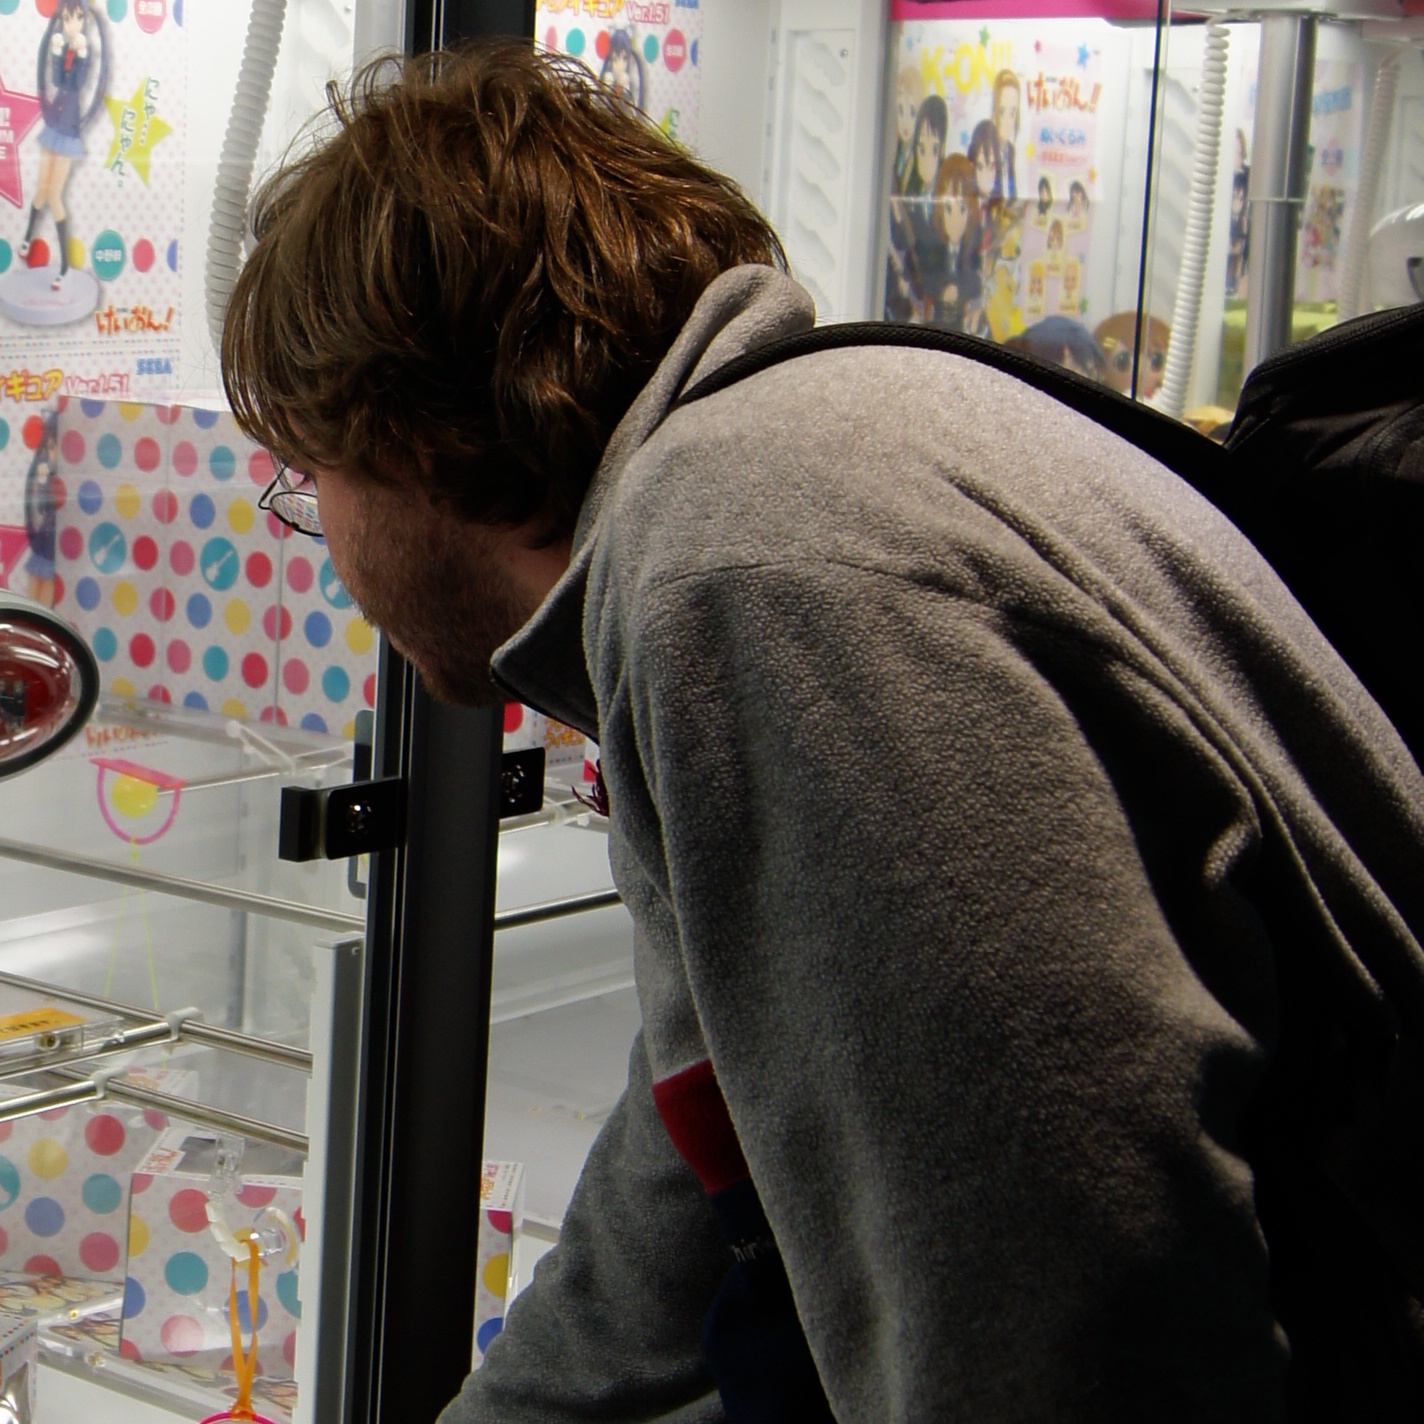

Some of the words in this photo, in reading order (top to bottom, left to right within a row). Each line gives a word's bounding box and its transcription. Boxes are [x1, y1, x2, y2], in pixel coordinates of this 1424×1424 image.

[94, 305, 174, 336] けいおん!
[136, 357, 173, 376] SEGA
